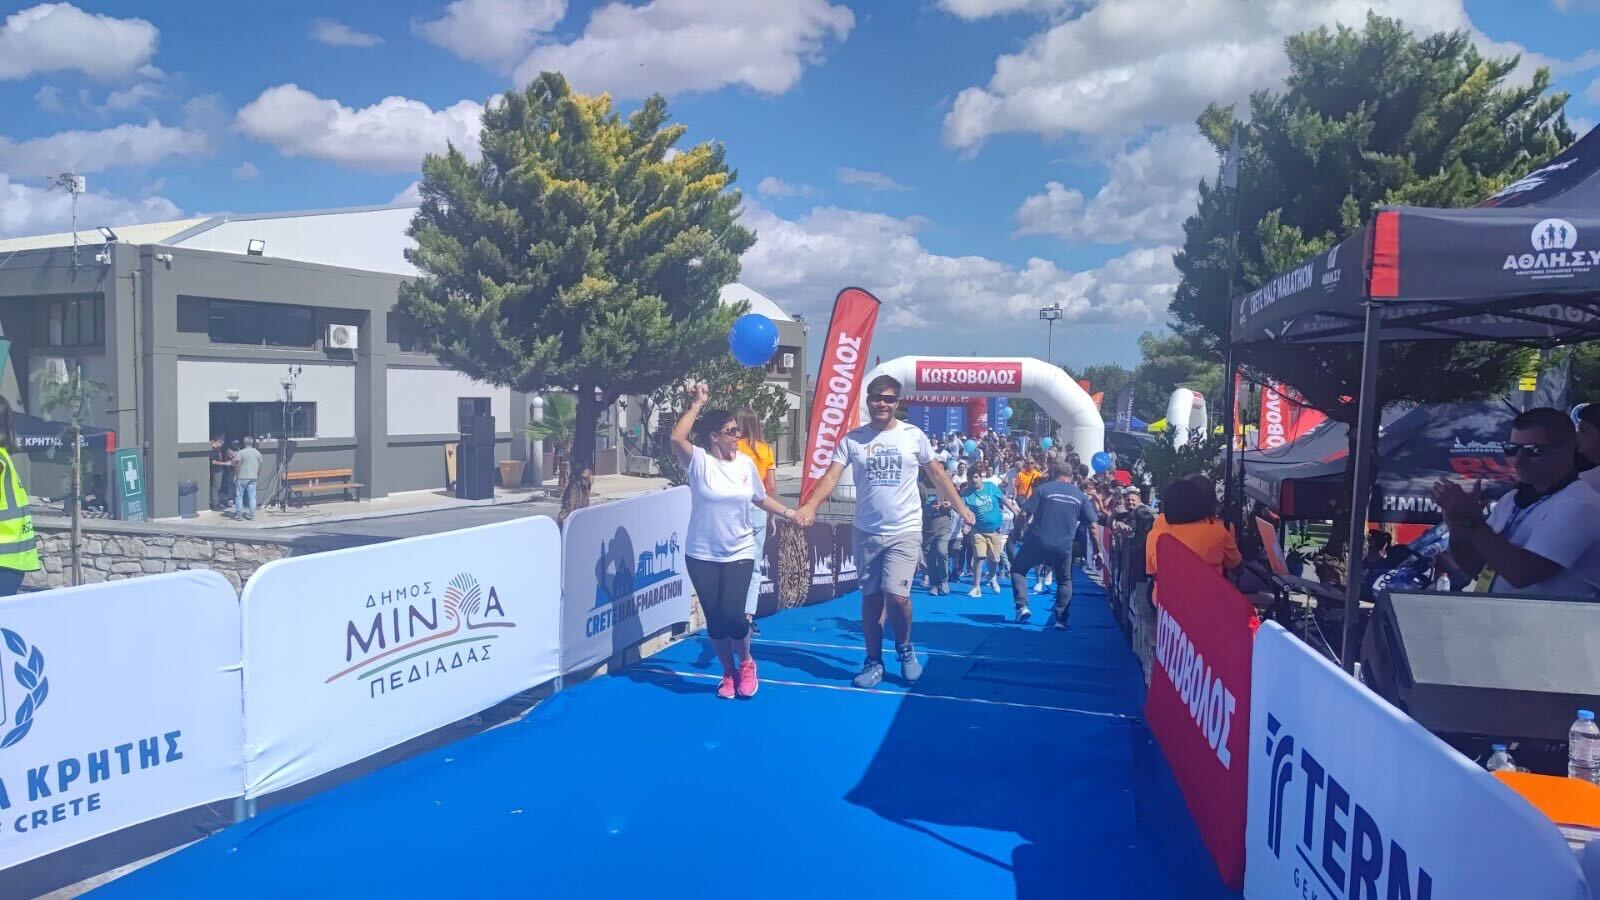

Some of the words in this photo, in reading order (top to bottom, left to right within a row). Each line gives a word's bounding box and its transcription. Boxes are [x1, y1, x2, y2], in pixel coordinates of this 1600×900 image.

[921, 368, 1016, 385] ΚΩΤΣΟΒΟΛΟΣ
[866, 455, 902, 471] RUN
[867, 470, 902, 480] CRETE
[366, 582, 432, 608] ΔΗΜΟΣ
[371, 645, 492, 699] ΠΕΔΙΑΔΑΣ
[27, 730, 184, 802] ΚΡΗΤΗΣ
[14, 793, 101, 833] CRETE
